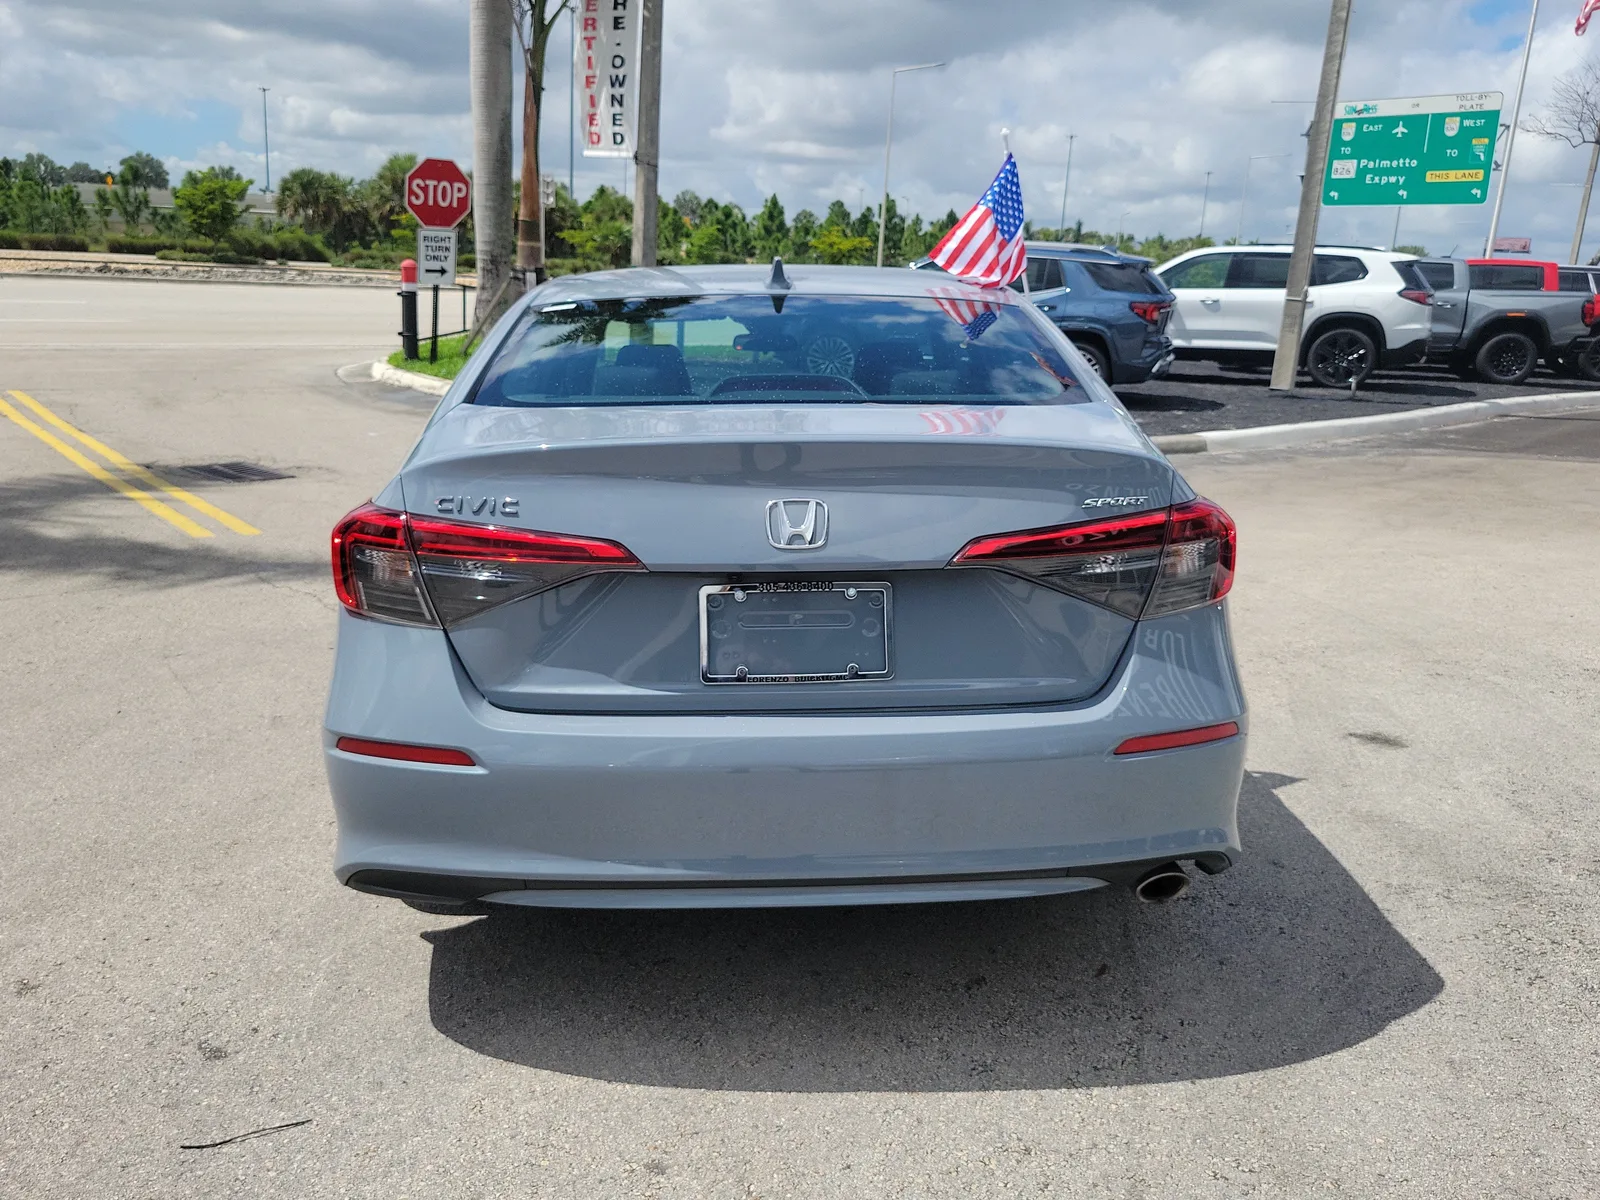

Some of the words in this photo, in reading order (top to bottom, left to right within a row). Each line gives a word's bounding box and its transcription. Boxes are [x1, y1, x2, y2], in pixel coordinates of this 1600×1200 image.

[1463, 119, 1486, 127] WEST
[1363, 124, 1383, 132] EAST
[1341, 147, 1351, 155] TO
[1446, 149, 1459, 157] TO
[1333, 167, 1351, 176] 826
[1360, 158, 1418, 169] Palmetto
[1454, 171, 1481, 179] LANE
[1365, 174, 1406, 185] Expwy
[410, 178, 467, 208] STOP
[425, 245, 451, 253] TURN
[435, 495, 519, 516] CIVIC
[1081, 495, 1149, 508] SPORT
